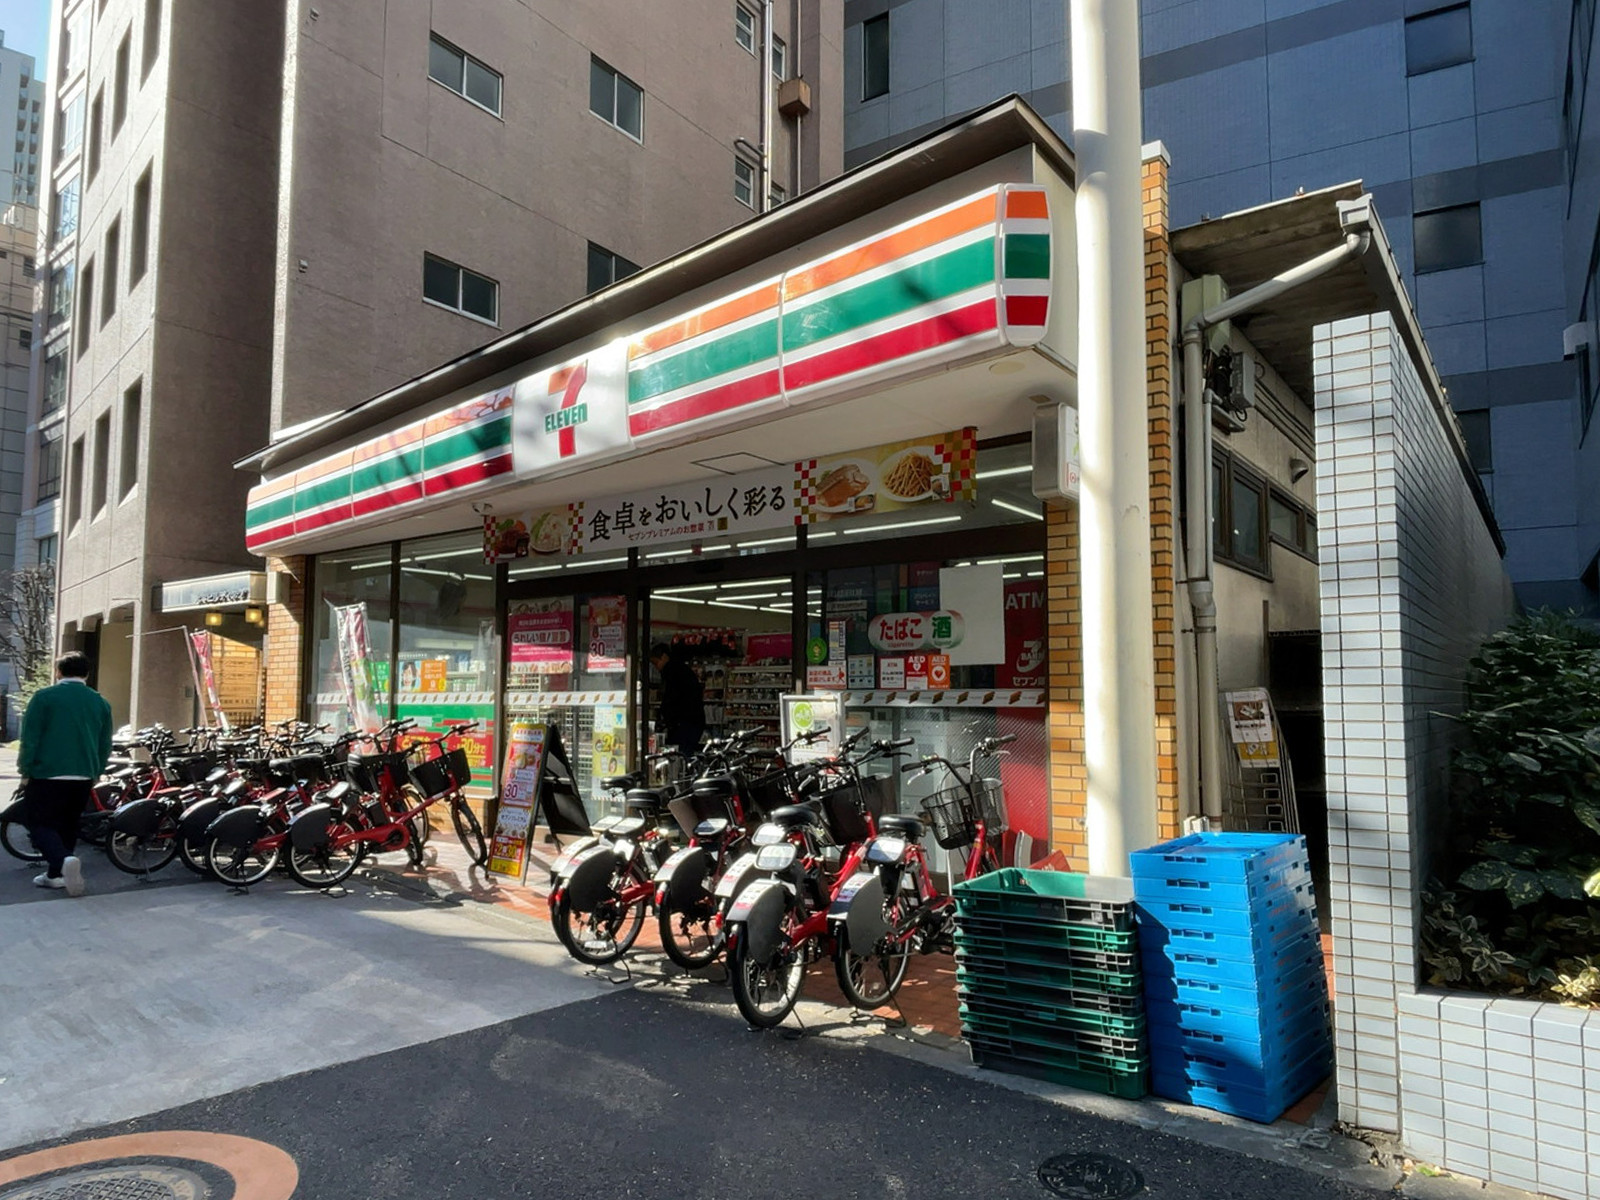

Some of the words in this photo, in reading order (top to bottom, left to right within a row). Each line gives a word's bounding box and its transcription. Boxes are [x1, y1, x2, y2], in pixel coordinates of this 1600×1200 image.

[548, 359, 588, 458] 7
[588, 486, 786, 543] 食卓をおいしく彩る
[1005, 591, 1045, 611] ATM
[879, 617, 923, 641] たばこ
[931, 615, 952, 639] 酒
[908, 655, 926, 663] AED
